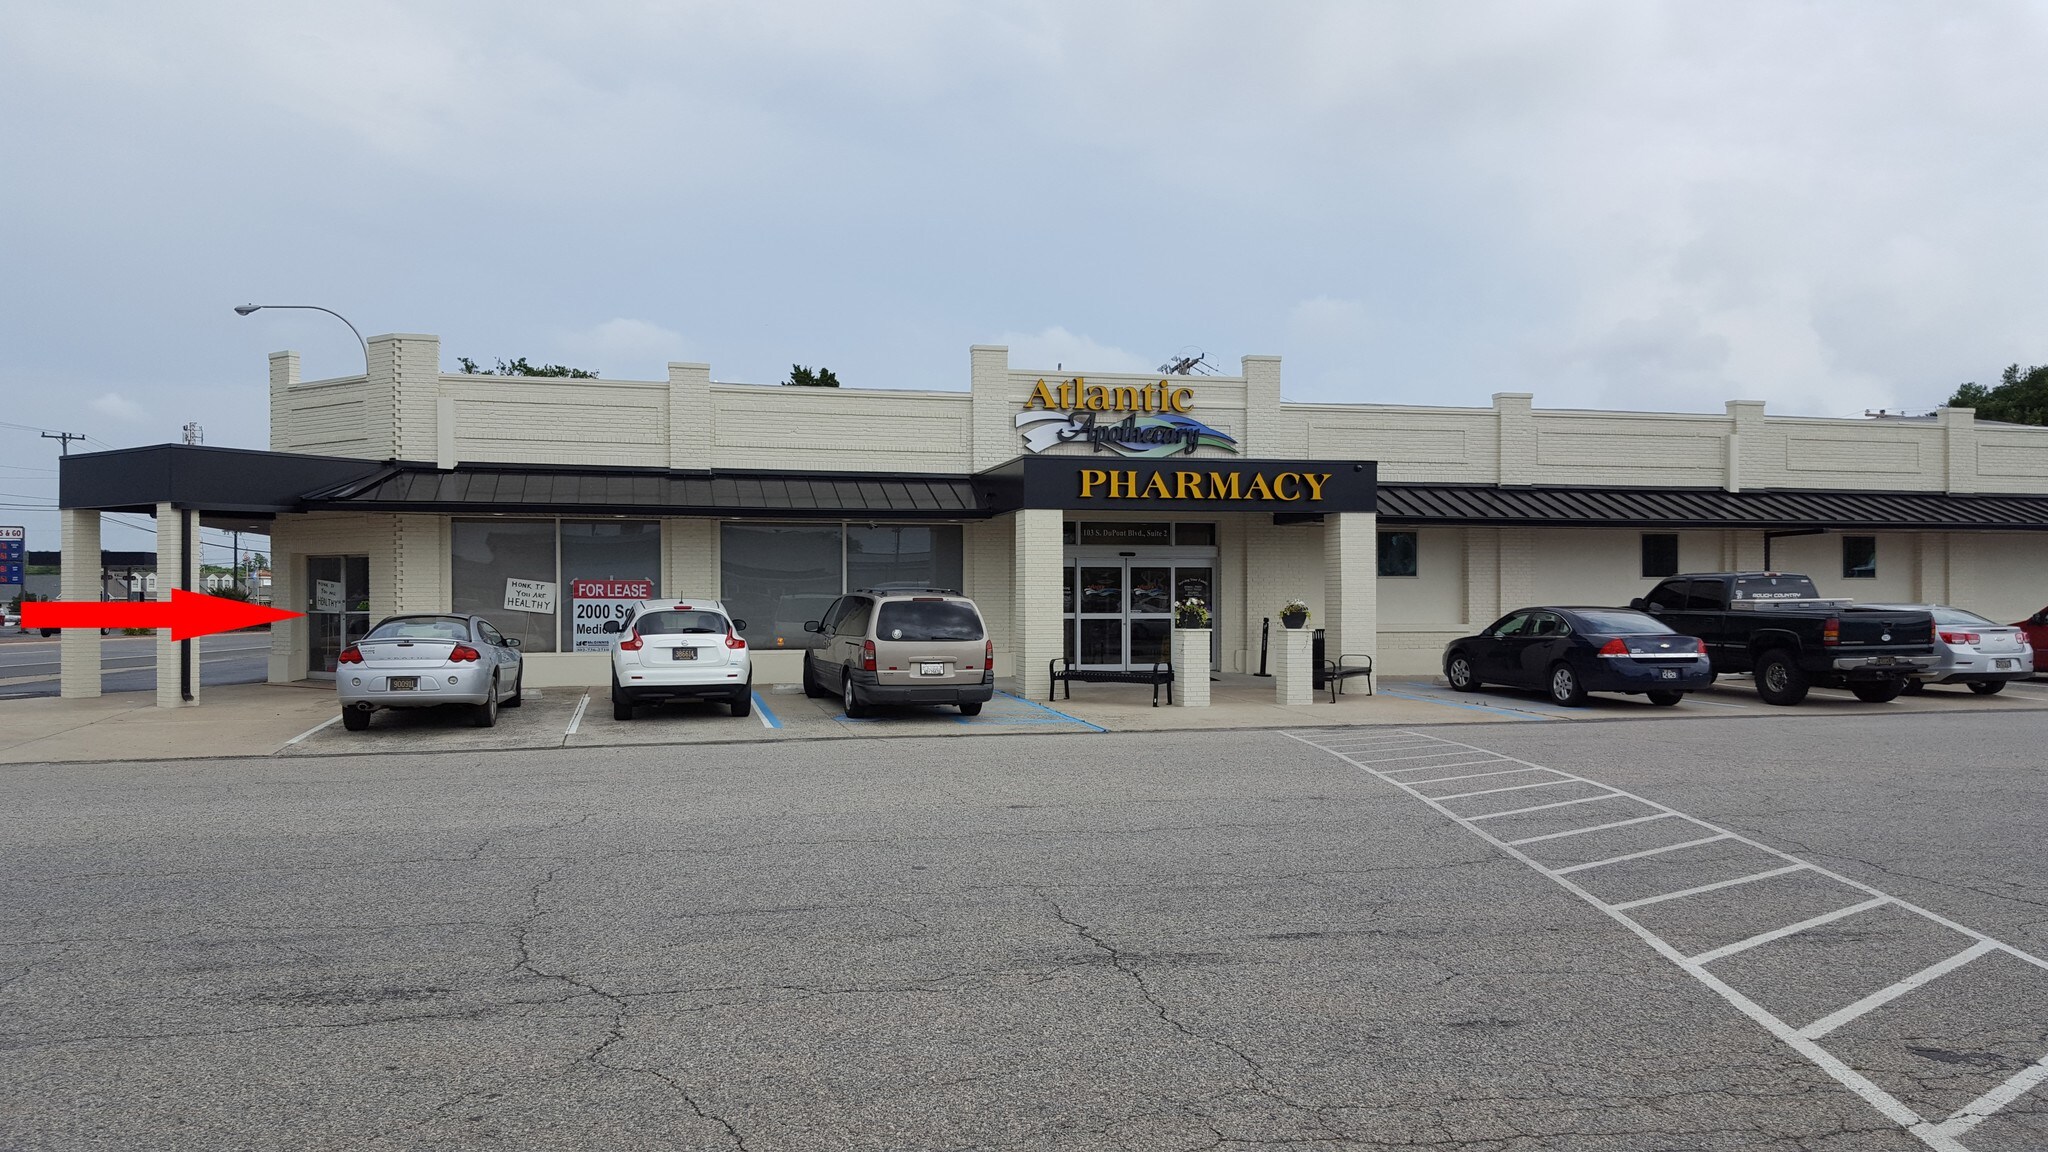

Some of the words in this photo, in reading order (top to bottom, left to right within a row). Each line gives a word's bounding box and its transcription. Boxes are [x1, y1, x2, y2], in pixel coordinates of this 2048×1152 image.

[1023, 376, 1195, 413] Atlantic
[1056, 411, 1200, 454] Apothecary
[1078, 469, 1333, 501] PHARMACY
[1147, 529, 1163, 537] Suite
[511, 581, 532, 589] HONK
[579, 583, 604, 597] FOR
[607, 584, 647, 597] LEASE
[507, 597, 551, 610] HEALTHY
[577, 604, 610, 619] 2000
